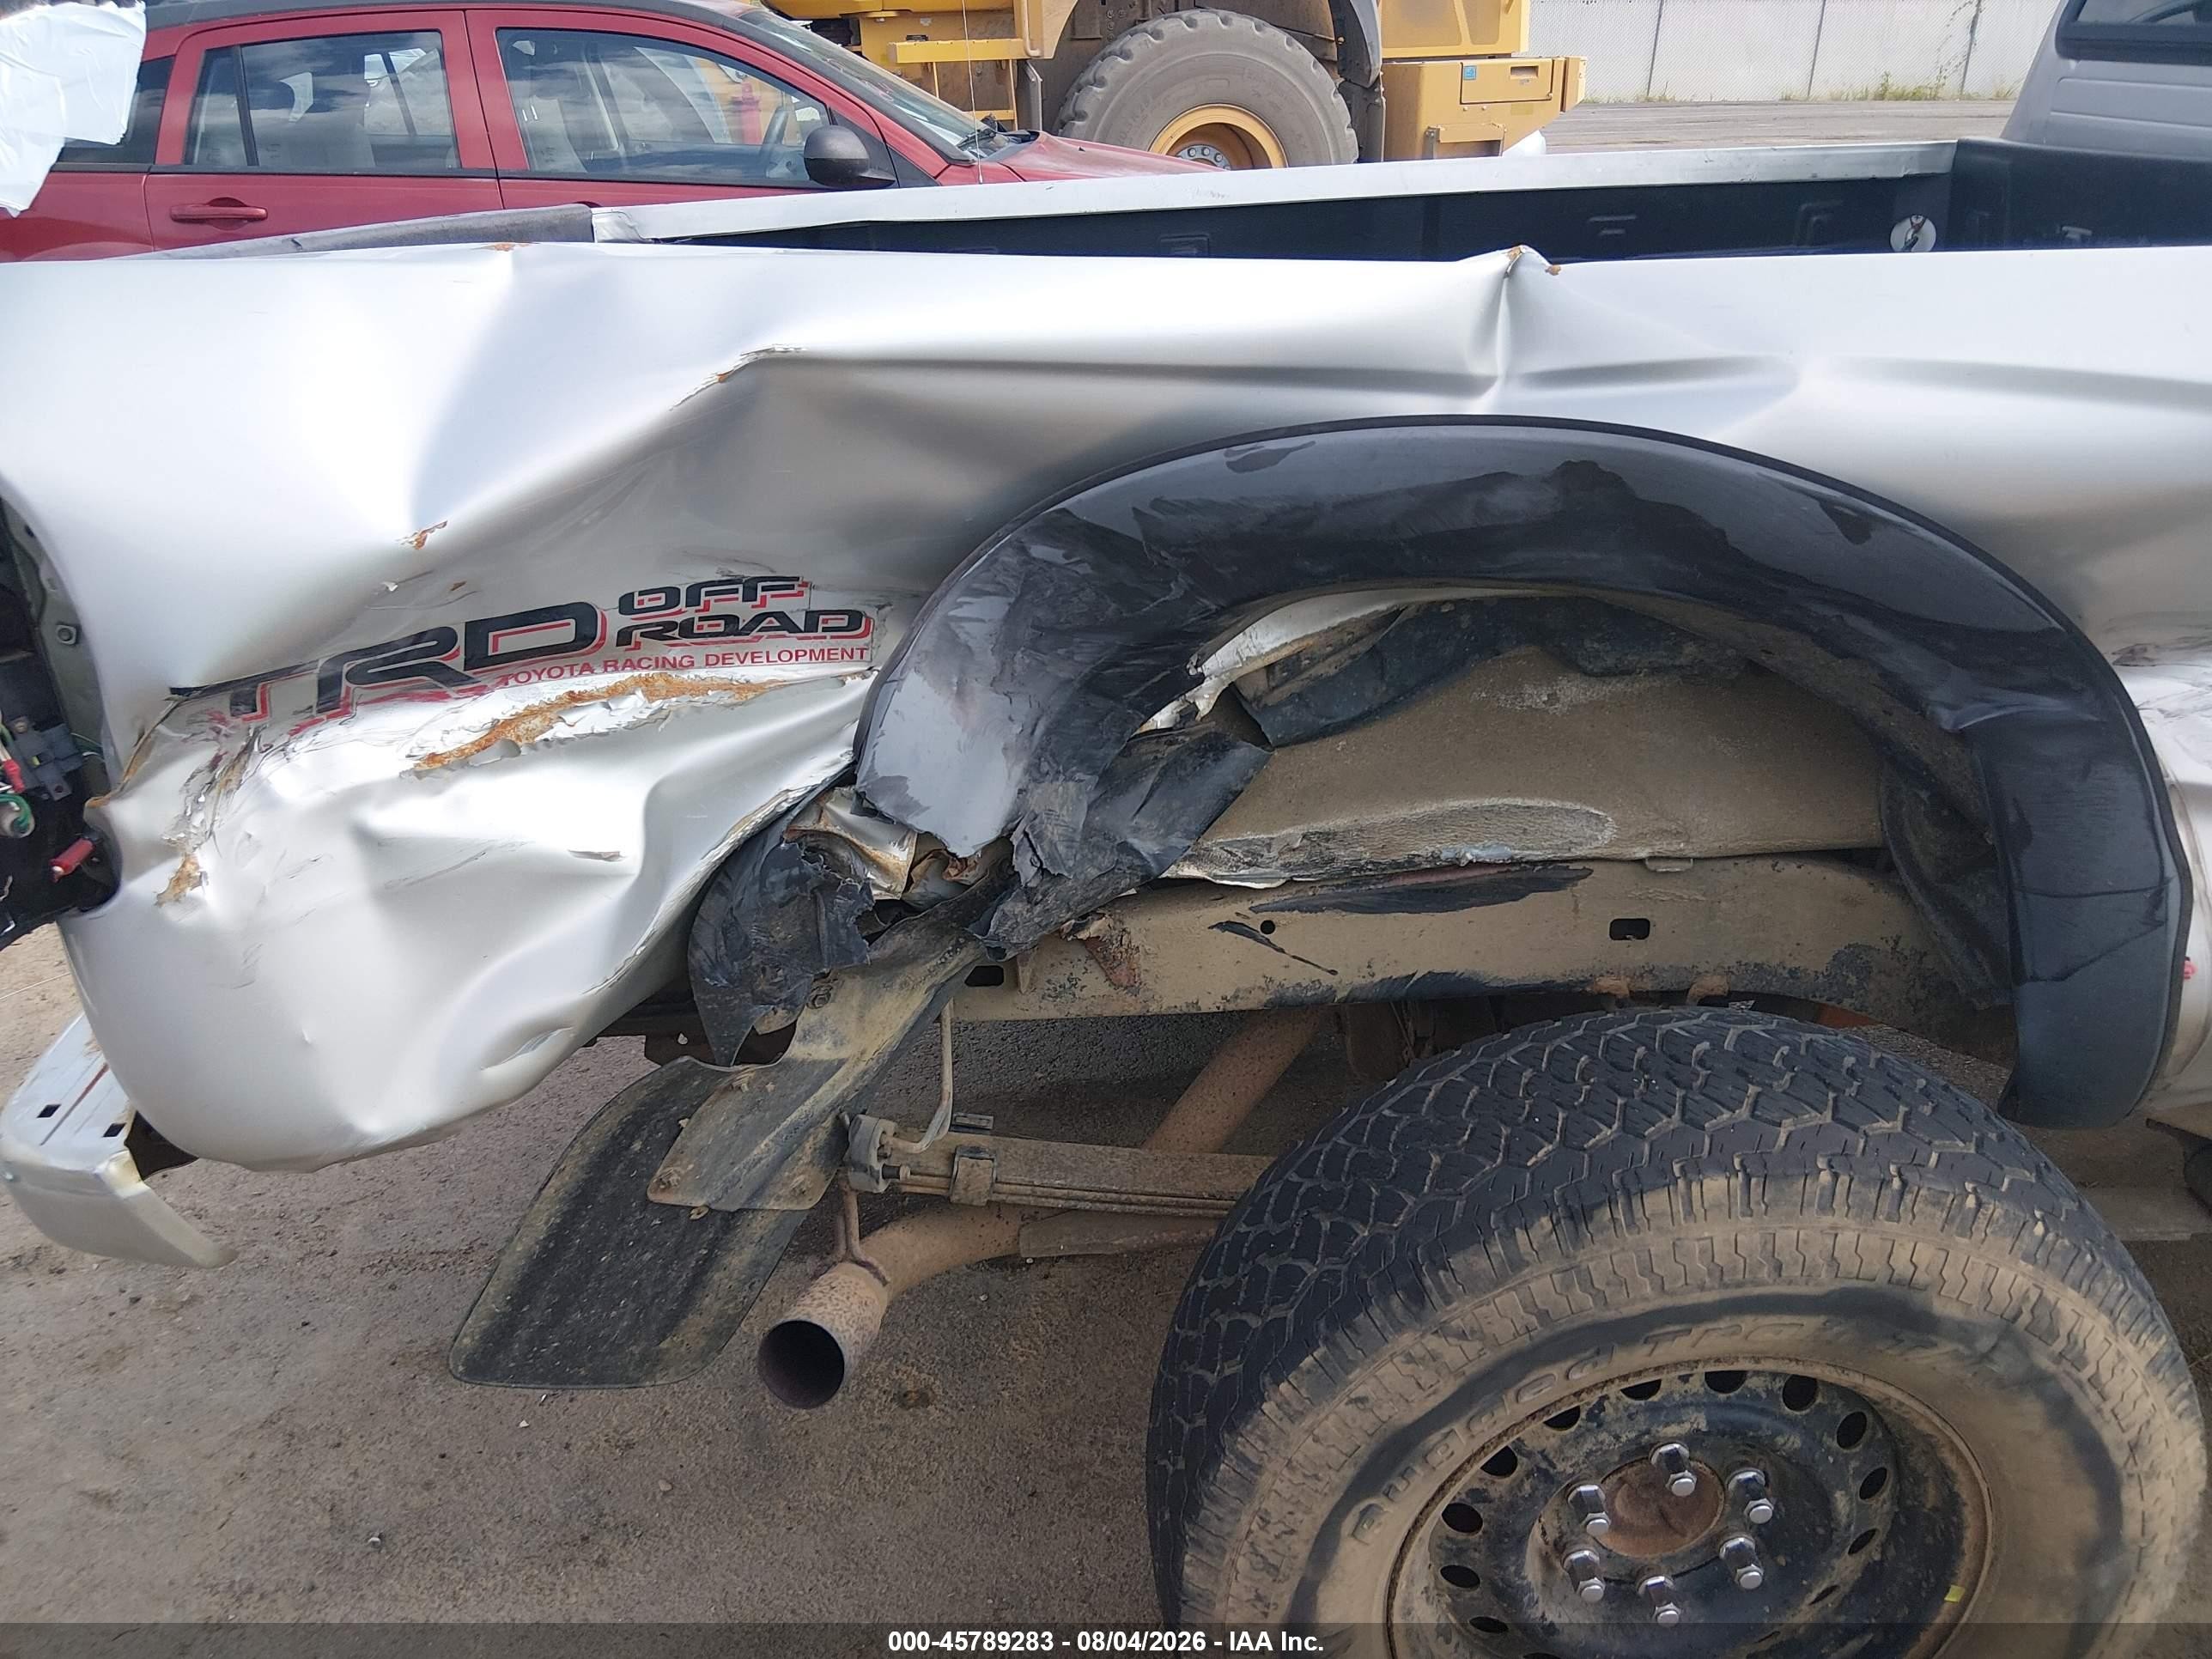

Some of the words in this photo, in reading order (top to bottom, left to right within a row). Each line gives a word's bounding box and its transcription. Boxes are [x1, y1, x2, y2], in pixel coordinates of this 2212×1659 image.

[618, 576, 809, 620] OFF
[616, 609, 874, 651] ROAD
[169, 601, 607, 730] TRD
[498, 662, 595, 686] TOYOTA
[603, 654, 695, 673] RACING
[705, 647, 868, 667] DEVELOPMENT
